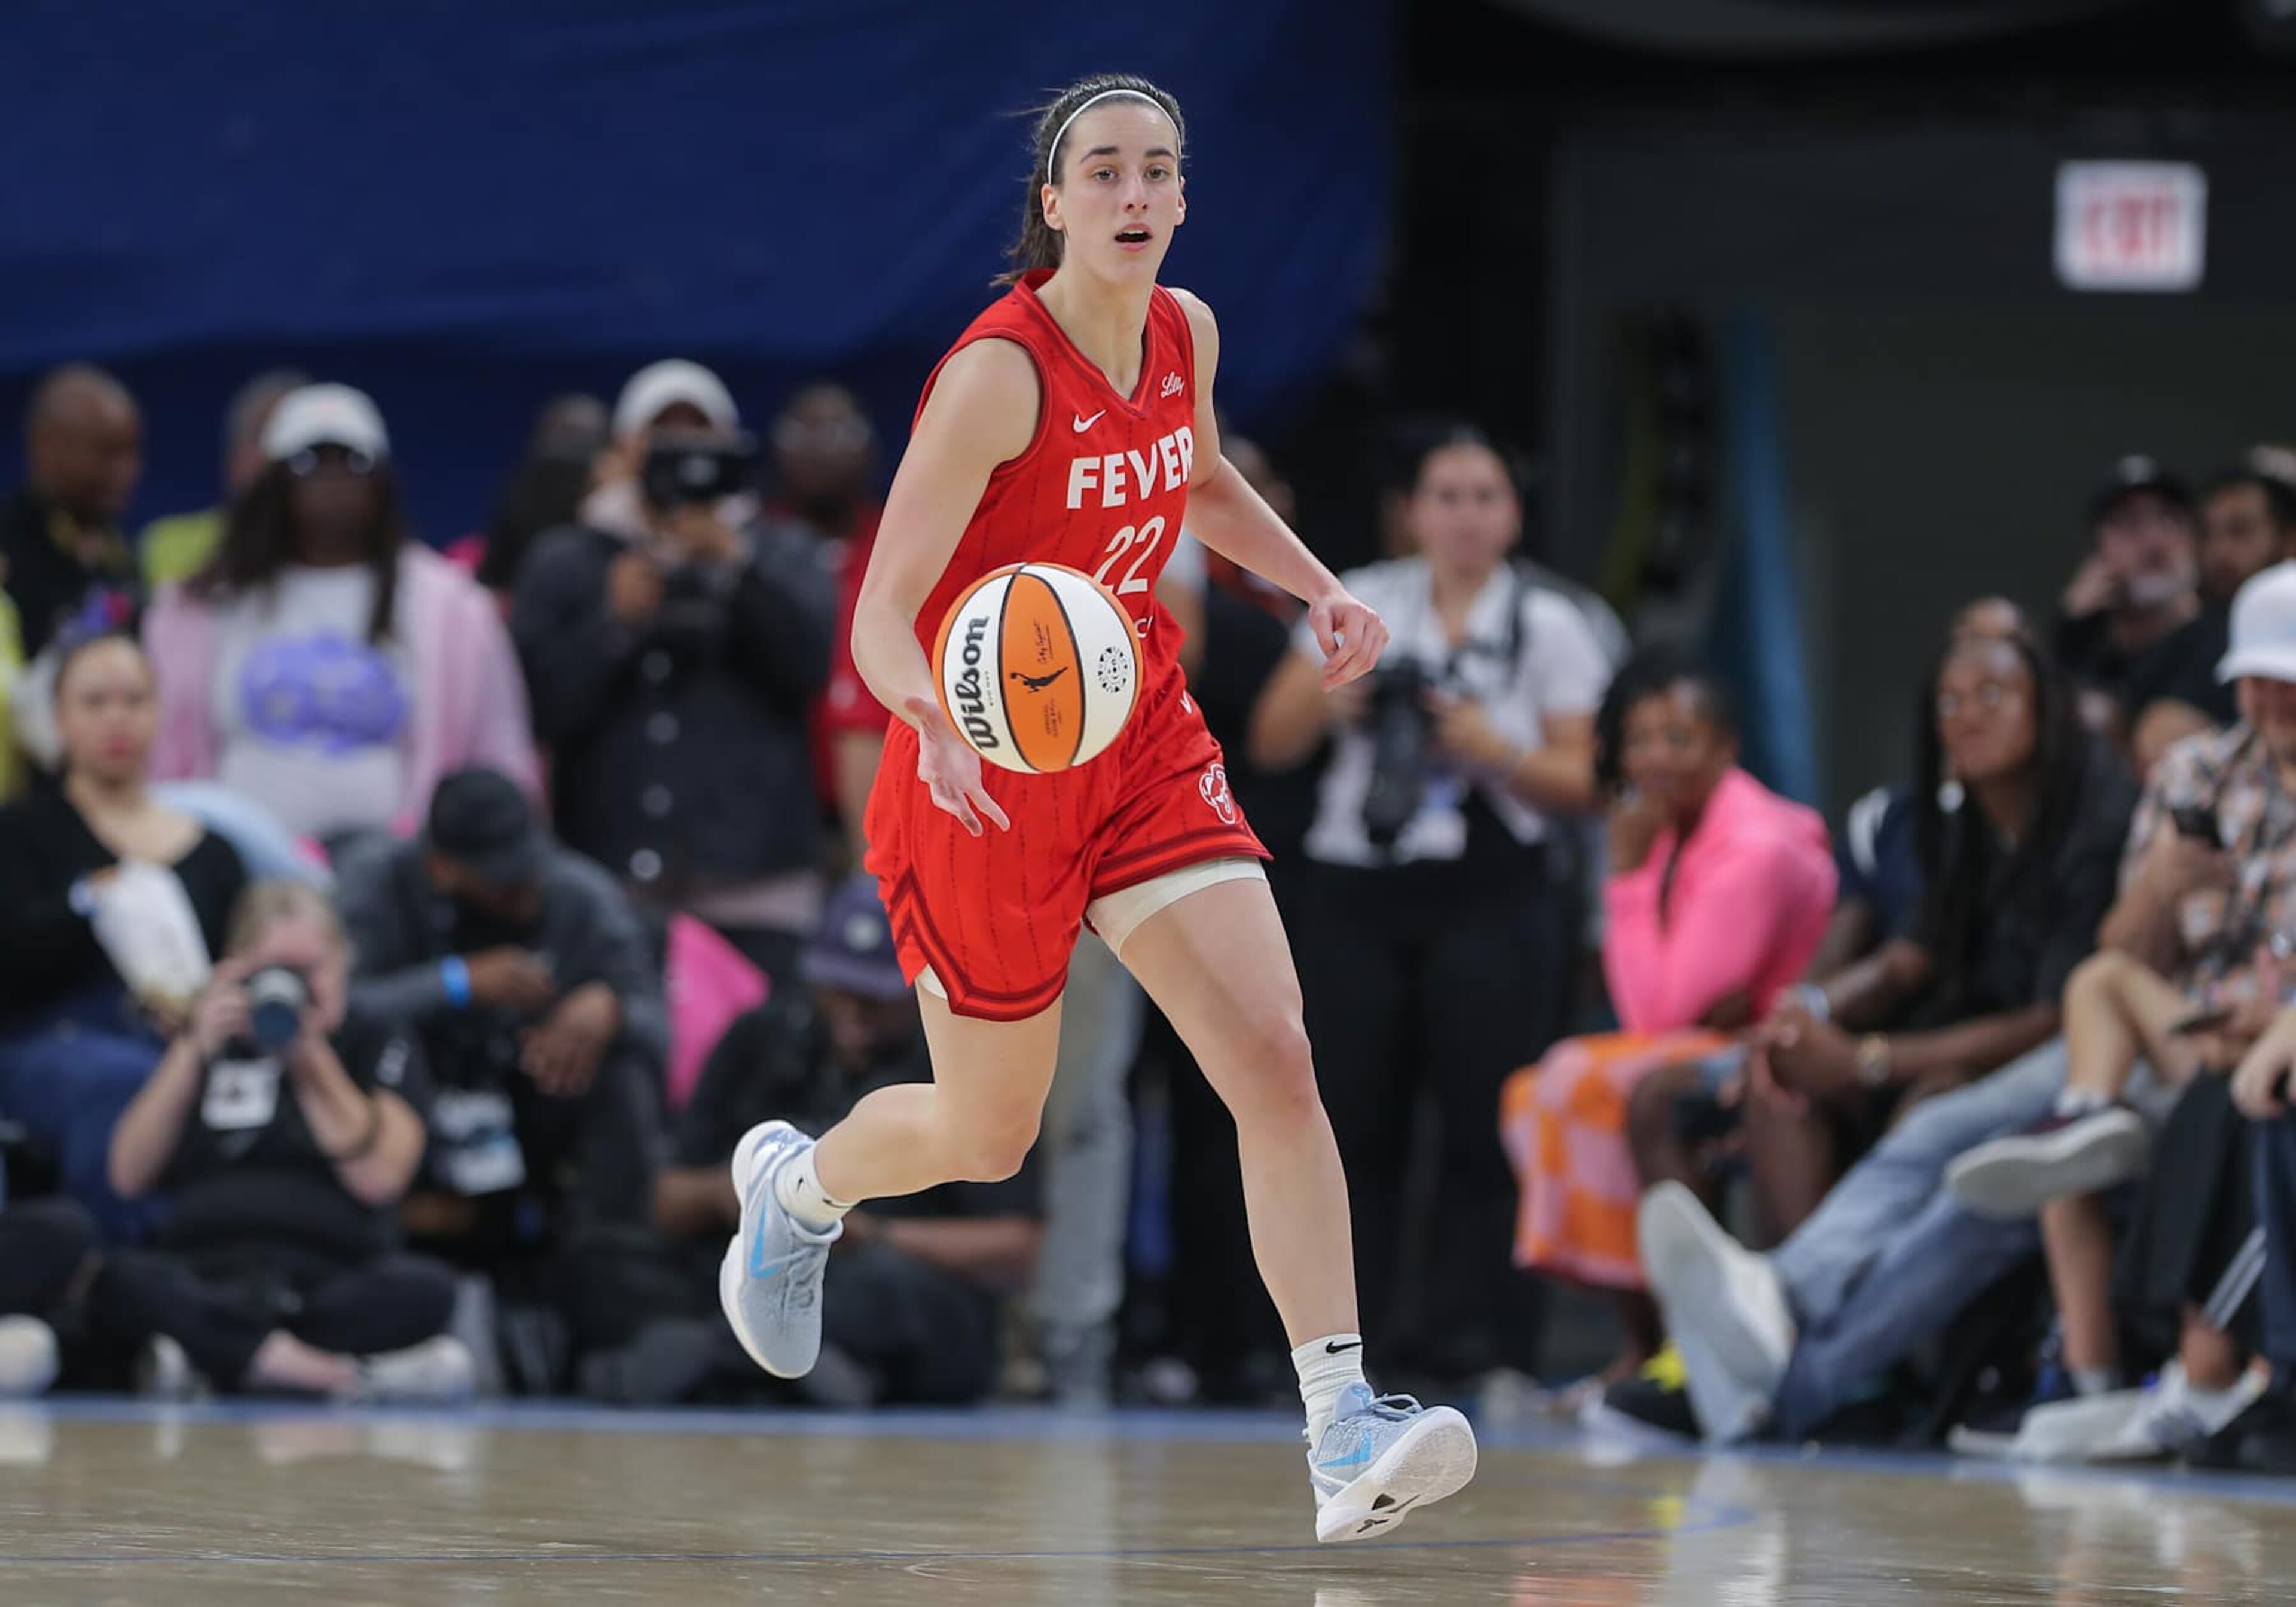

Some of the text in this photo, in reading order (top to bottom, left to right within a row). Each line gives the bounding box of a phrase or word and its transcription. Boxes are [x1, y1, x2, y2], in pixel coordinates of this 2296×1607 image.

[1161, 371, 1184, 398] Lilly
[1067, 426, 1193, 509] FEVER
[1094, 515, 1165, 595] 22
[955, 616, 1000, 750] Wilson
